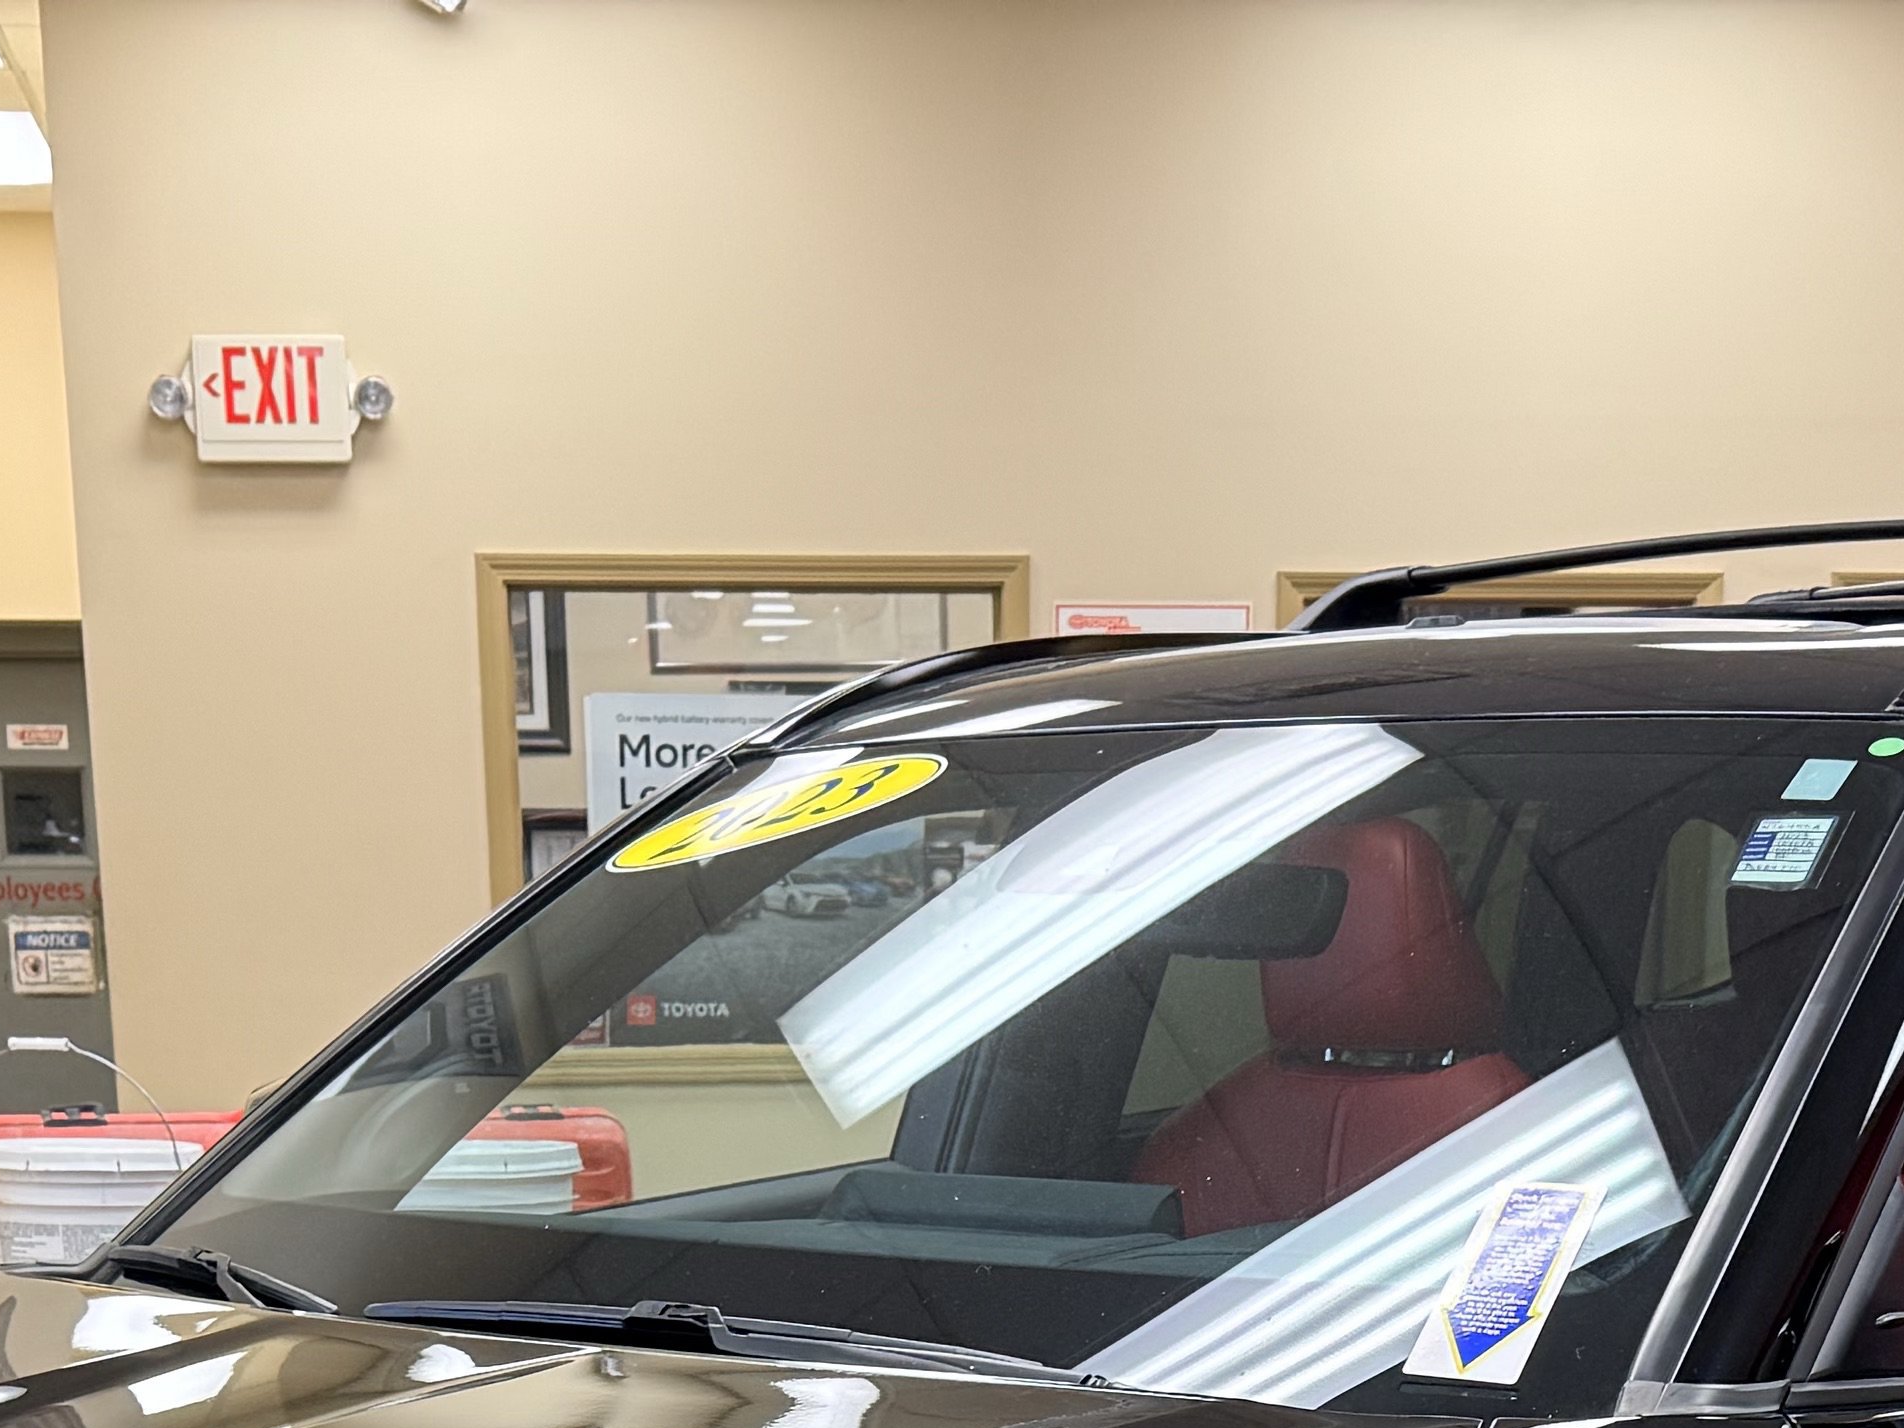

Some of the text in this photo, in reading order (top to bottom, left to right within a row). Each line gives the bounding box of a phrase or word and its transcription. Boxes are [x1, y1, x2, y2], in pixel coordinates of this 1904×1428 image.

[221, 345, 323, 426] EXIT
[619, 734, 716, 768] More
[648, 763, 899, 860] 2023
[26, 934, 78, 948] NOTICE
[661, 1001, 730, 1018] TOYOTA
